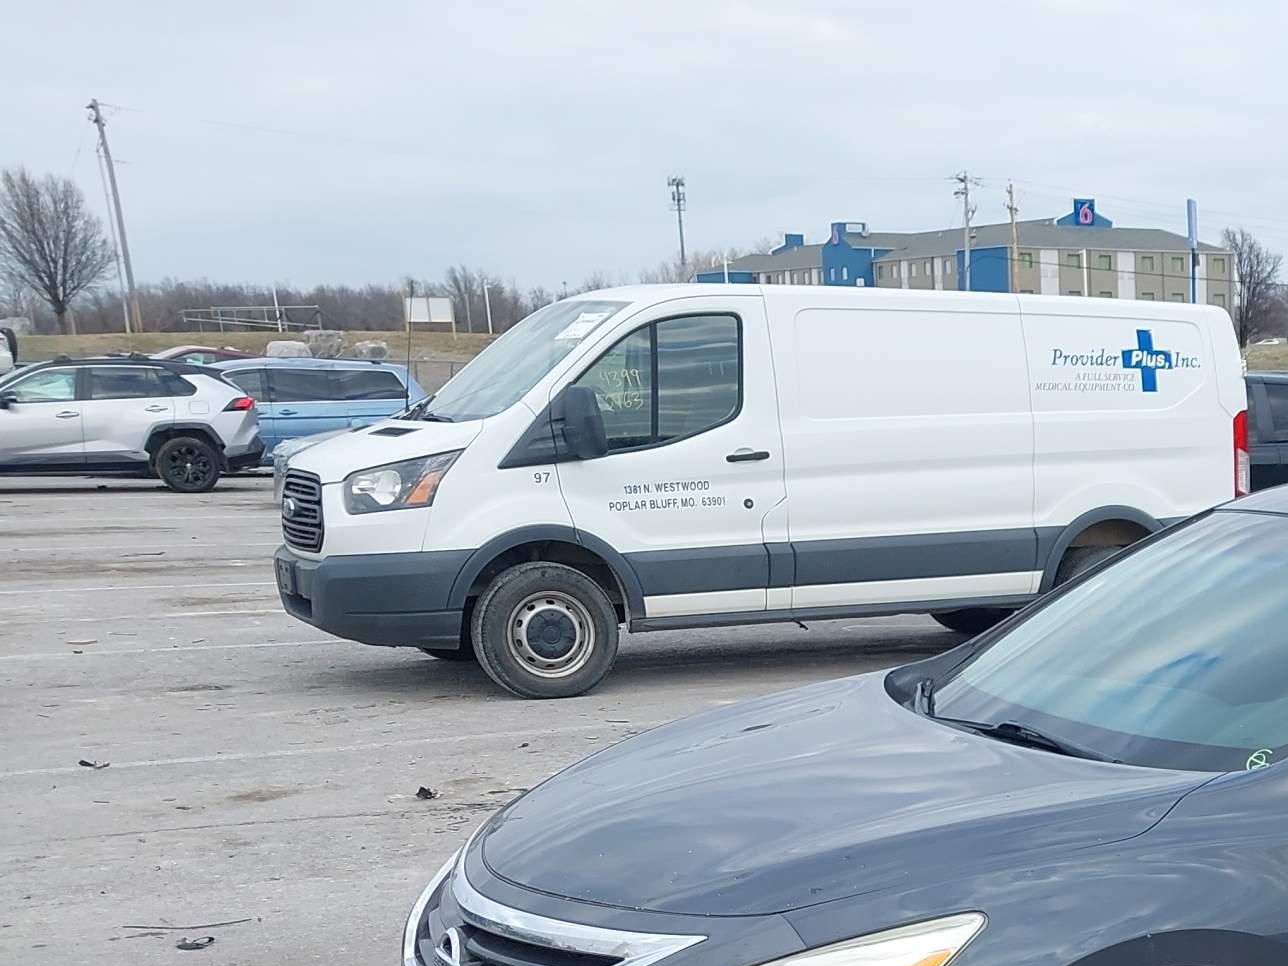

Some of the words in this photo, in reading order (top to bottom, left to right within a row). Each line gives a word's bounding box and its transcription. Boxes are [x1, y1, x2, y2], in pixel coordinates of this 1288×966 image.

[1079, 202, 1093, 224] 6
[1051, 349, 1120, 367] Provider
[1131, 350, 1171, 368] Plus,
[1174, 352, 1201, 368] Inc.
[1081, 373, 1103, 381] FULL
[1103, 373, 1136, 382] SERVICE
[1035, 382, 1073, 392] MEDICAL
[1073, 382, 1122, 393] EQUIPMENT
[533, 472, 550, 484] 97
[623, 484, 641, 495] 1381
[643, 483, 653, 494] N.
[654, 480, 710, 493] WESTWOOD
[608, 500, 647, 512] POPLAR
[649, 498, 680, 510] BLUFF,
[680, 497, 698, 508] MO.
[701, 496, 726, 507] 63901
